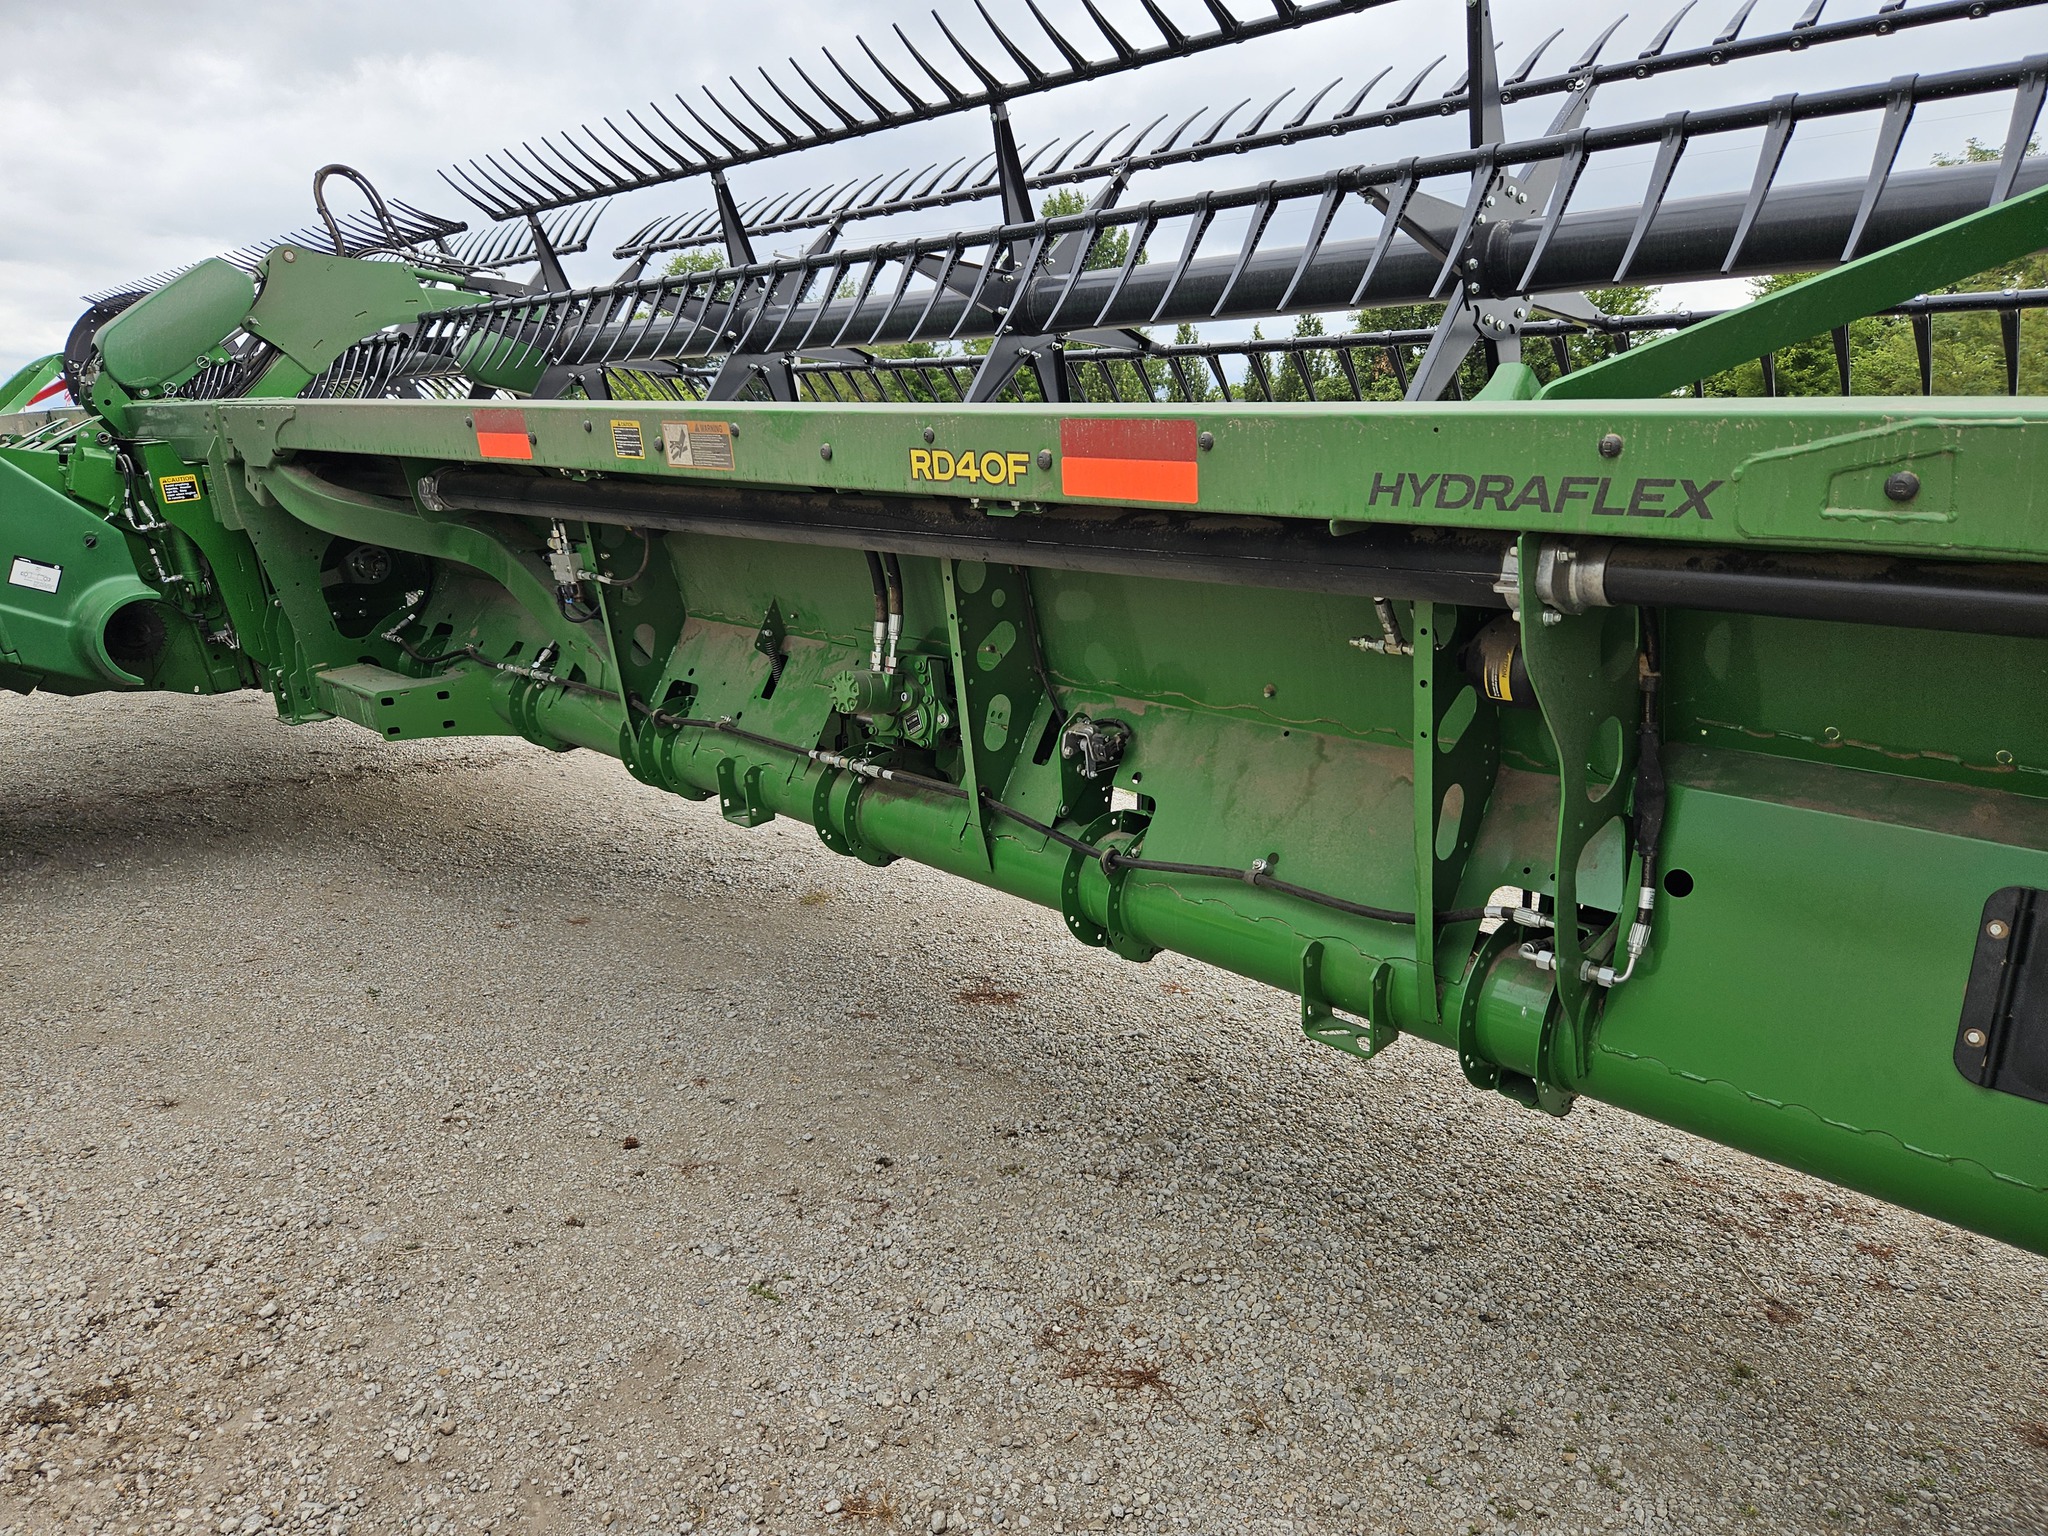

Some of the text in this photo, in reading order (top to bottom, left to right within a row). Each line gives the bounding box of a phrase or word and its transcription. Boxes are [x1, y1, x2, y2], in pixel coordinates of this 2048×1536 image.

[700, 425, 723, 433] WARNING
[910, 449, 1030, 486] RD40F
[1368, 472, 1724, 520] HYDRAFLEX
